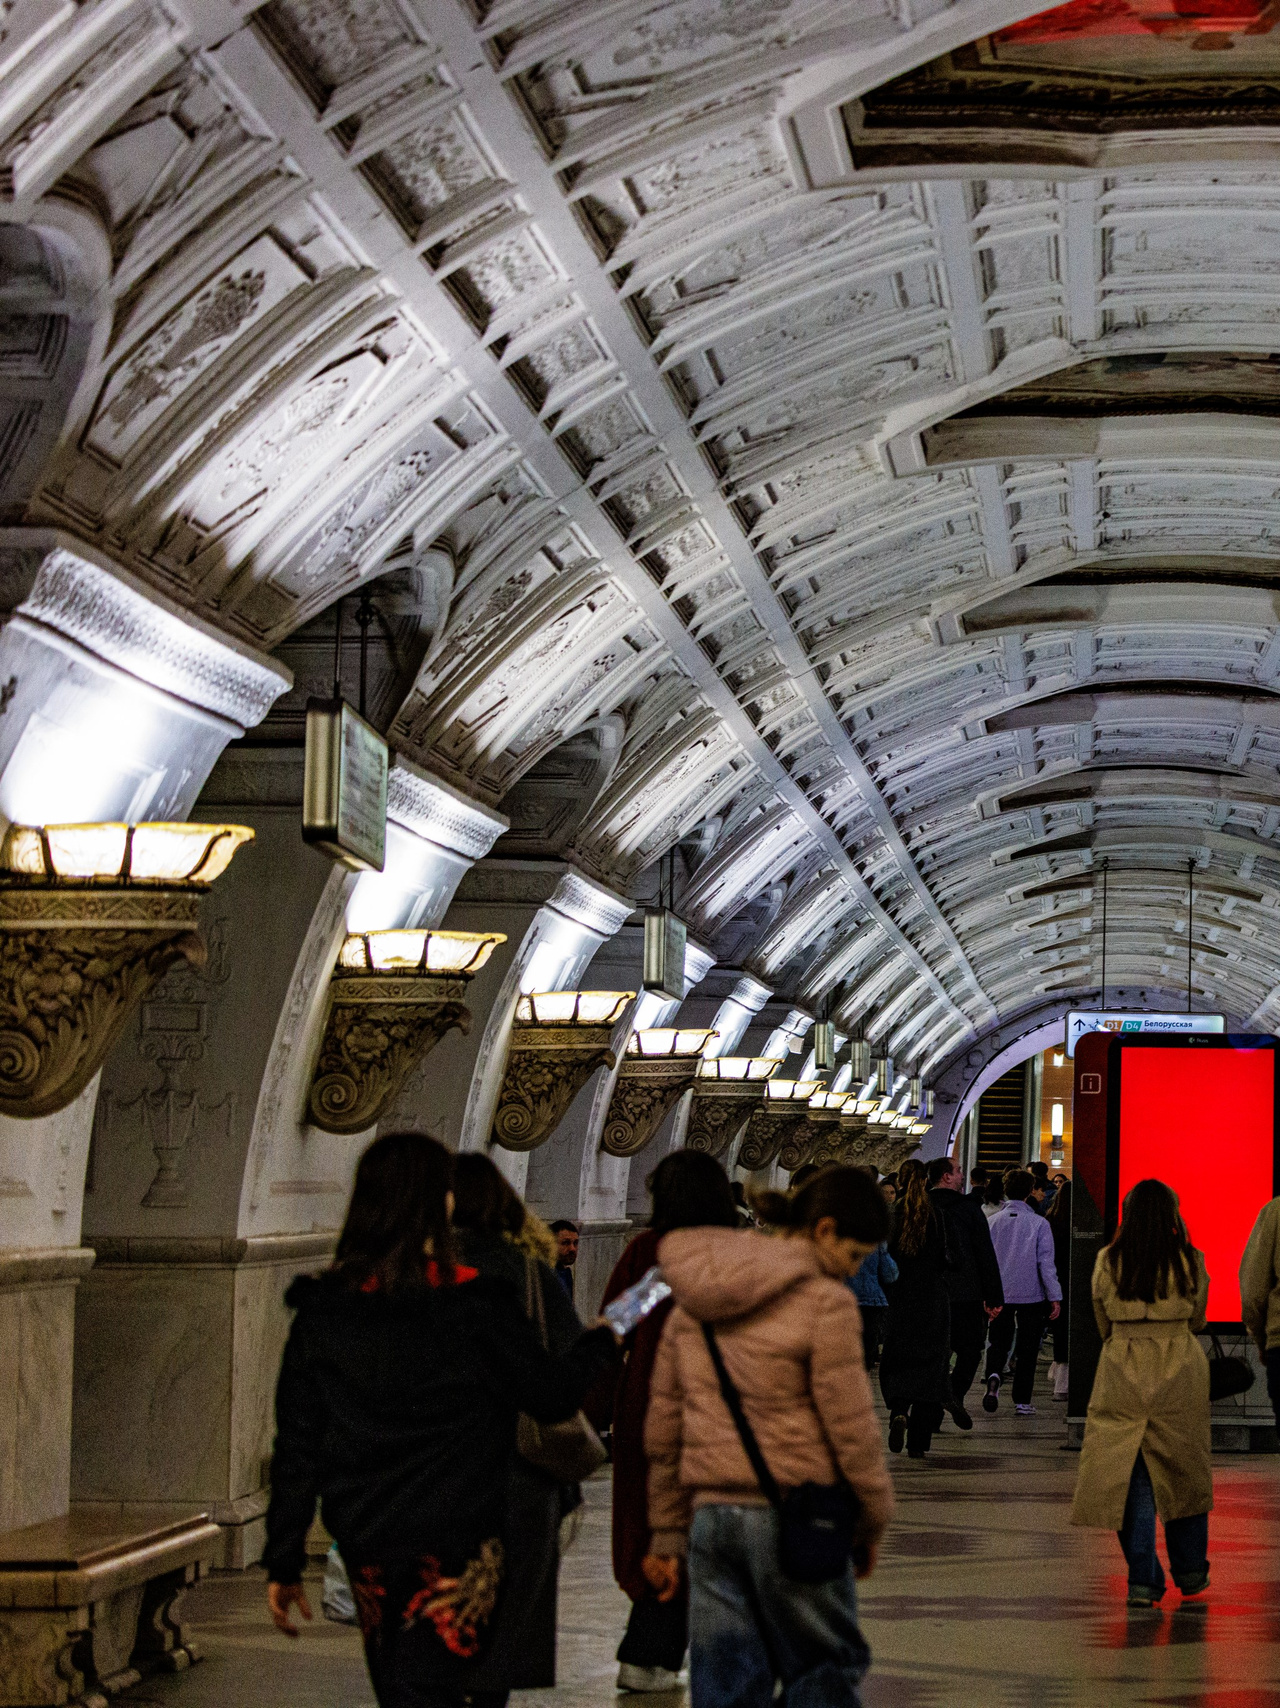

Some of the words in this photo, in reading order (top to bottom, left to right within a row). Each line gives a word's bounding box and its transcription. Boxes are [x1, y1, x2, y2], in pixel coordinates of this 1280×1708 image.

[1106, 1021, 1119, 1030] D1
[1126, 1022, 1139, 1030] D4
[1144, 1019, 1193, 1029] Белорусская
